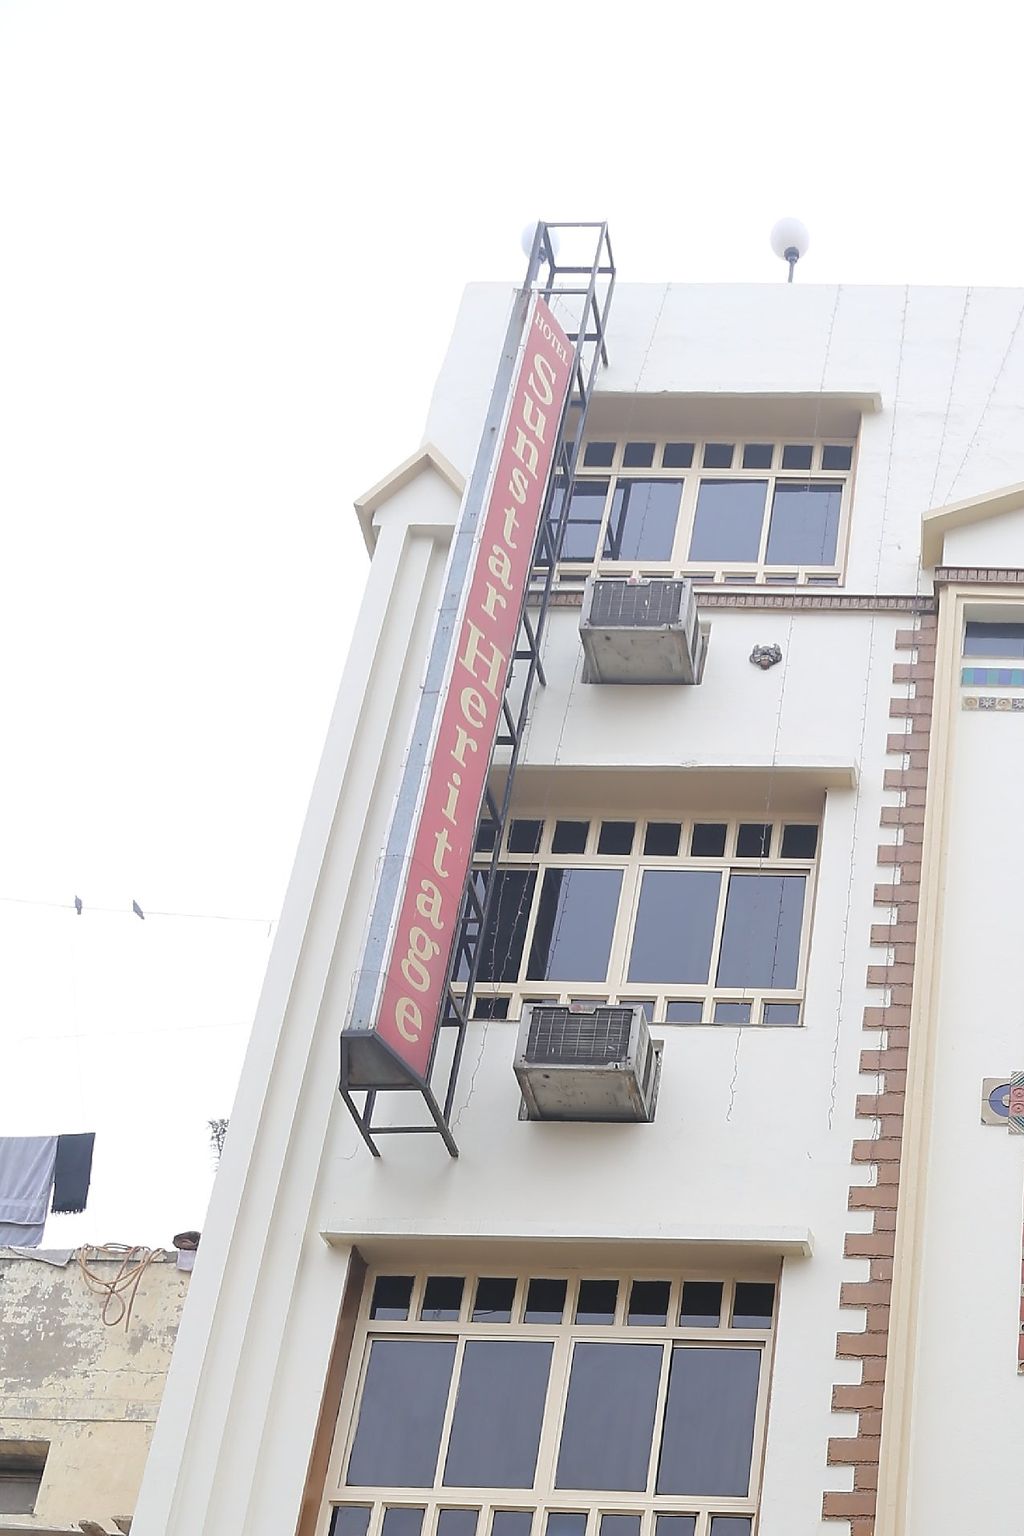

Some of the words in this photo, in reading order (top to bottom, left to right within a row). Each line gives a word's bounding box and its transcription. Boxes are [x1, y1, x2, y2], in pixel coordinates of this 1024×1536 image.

[533, 310, 570, 366] HOTEL
[481, 352, 558, 622] Sunstar
[394, 618, 507, 1045] Heritage
